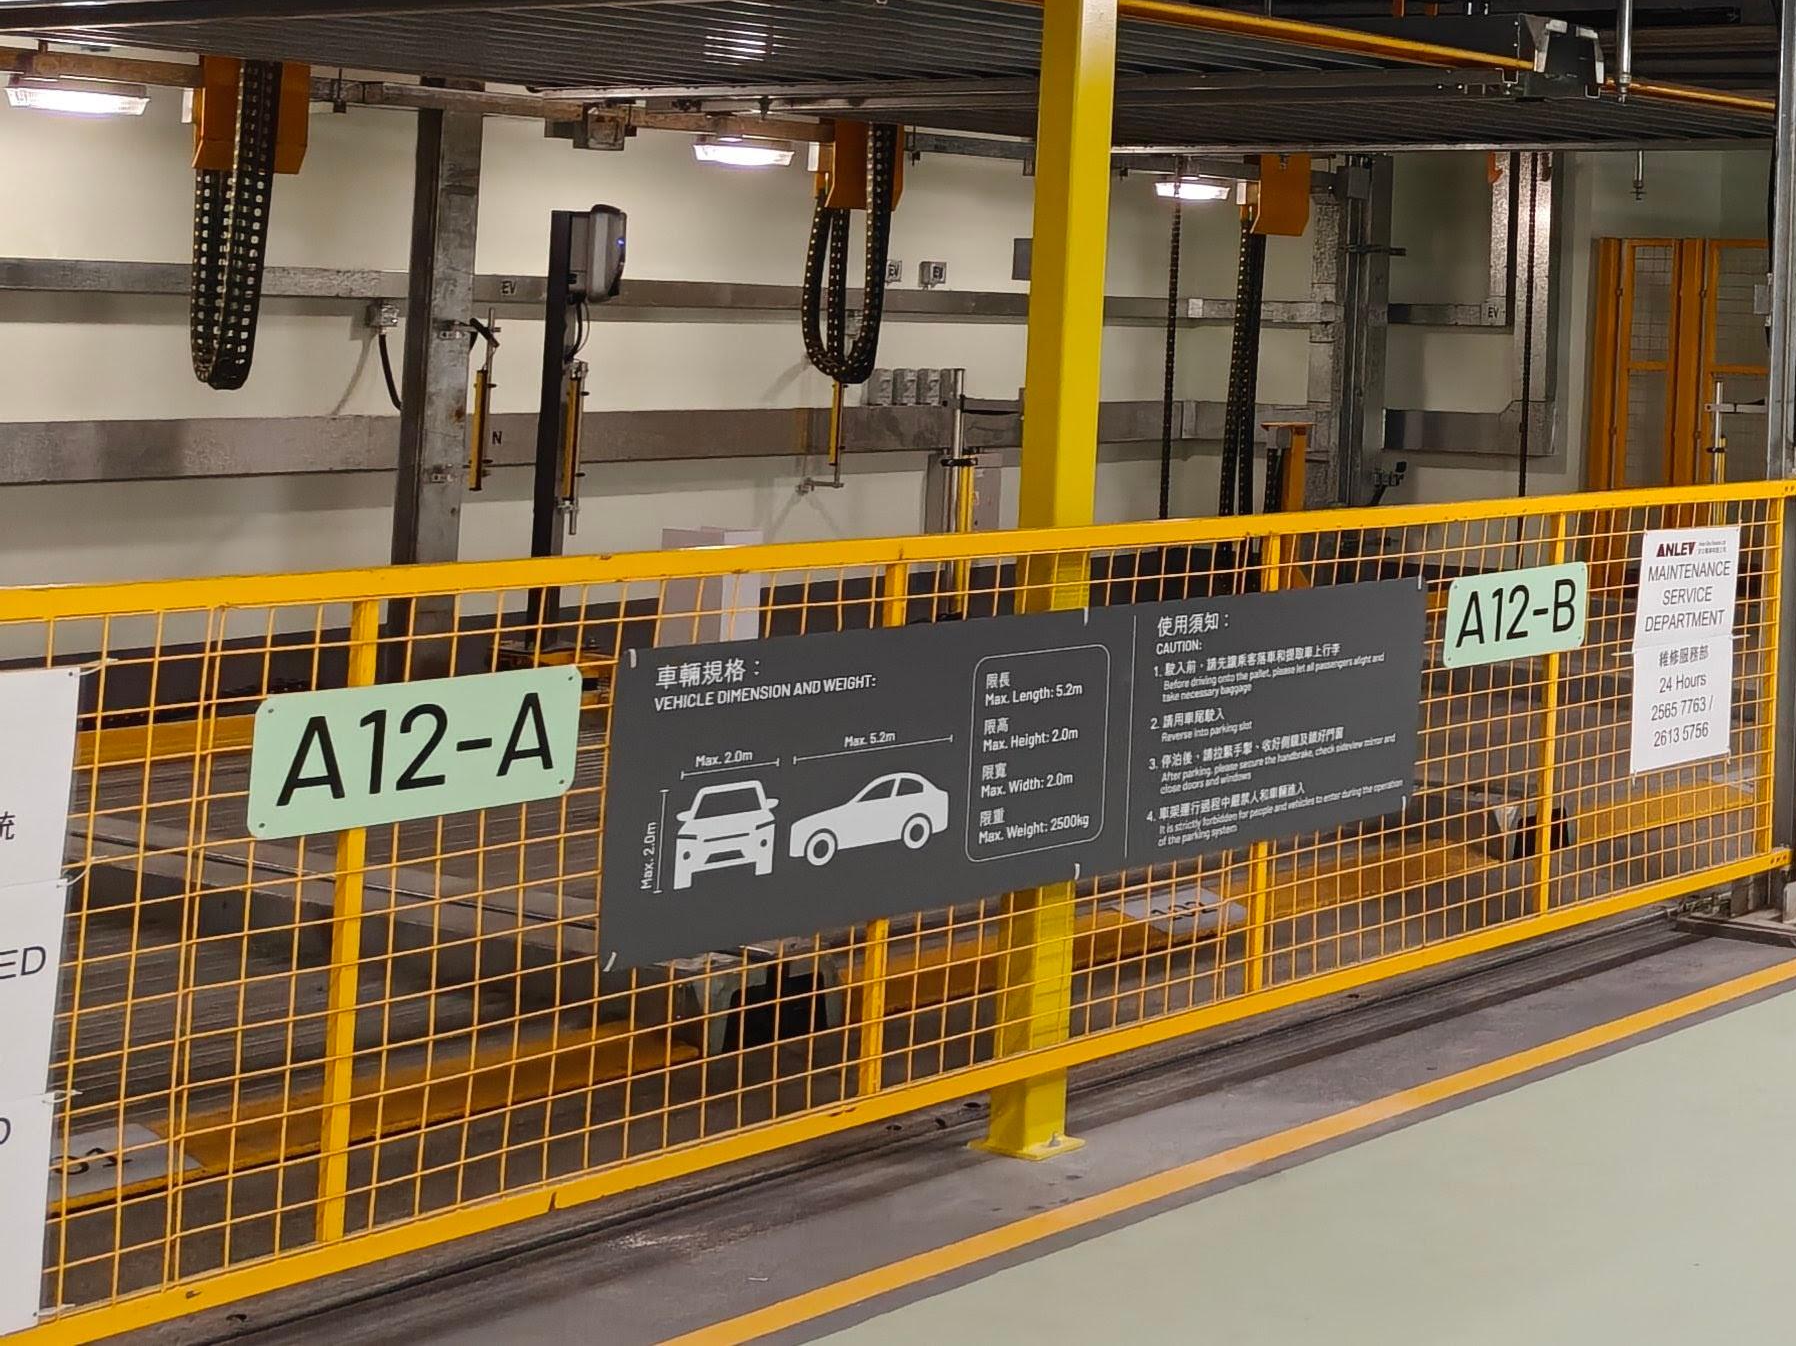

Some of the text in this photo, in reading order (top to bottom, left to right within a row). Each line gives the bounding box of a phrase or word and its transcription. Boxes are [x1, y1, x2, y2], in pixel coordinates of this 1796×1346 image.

[501, 280, 517, 295] EV
[1487, 306, 1500, 319] EV
[492, 431, 503, 445] N
[1656, 541, 1697, 558] ANLEV
[1648, 560, 1731, 582] MAINTENANCE
[1662, 585, 1713, 606] SERVICE
[1455, 578, 1577, 649] A12-B
[1644, 609, 1726, 633] DEPARTMENT
[1156, 639, 1202, 654] CAUTION:
[1658, 644, 1710, 668] 維修服務部
[1163, 679, 1189, 690] Before
[1190, 675, 1216, 687] driving
[1236, 672, 1248, 681] the
[1181, 688, 1219, 699] necessary
[1220, 683, 1251, 696] baggage
[1659, 674, 1707, 693] 24 Hours
[654, 674, 876, 711] VEHICLE DIMENSION AND WEIGHT:
[985, 683, 1082, 706] Max. Length: 5.2m
[1651, 701, 1678, 722] 2565
[1680, 697, 1707, 717] 7763
[844, 731, 895, 747] Max. 5.2m
[983, 728, 1078, 752] Max. Height: 2.0m
[1161, 731, 1192, 742] Reverse
[1210, 723, 1238, 737] parking
[1653, 723, 1709, 748] 2613 5756
[276, 690, 556, 808] A12-A
[695, 750, 752, 767] Max. 2.0m
[1161, 771, 1181, 782] After
[1214, 763, 1238, 775] please
[1239, 758, 1264, 769] secure
[1264, 755, 1276, 765] the
[981, 772, 1072, 798] Max. Width: 2.0m
[1160, 784, 1181, 794] close
[1182, 780, 1204, 791] doors
[1205, 774, 1219, 787] and
[978, 814, 1089, 844] Max. Weight: 2500kg
[1173, 818, 1203, 837] strictly
[1202, 813, 1237, 826] forbidden
[1238, 810, 1249, 819] for
[1249, 805, 1273, 819] people
[1168, 835, 1181, 844] the
[1182, 828, 1210, 844] parking
[1211, 825, 1237, 838] system
[640, 822, 656, 889] Max. 2.0m
